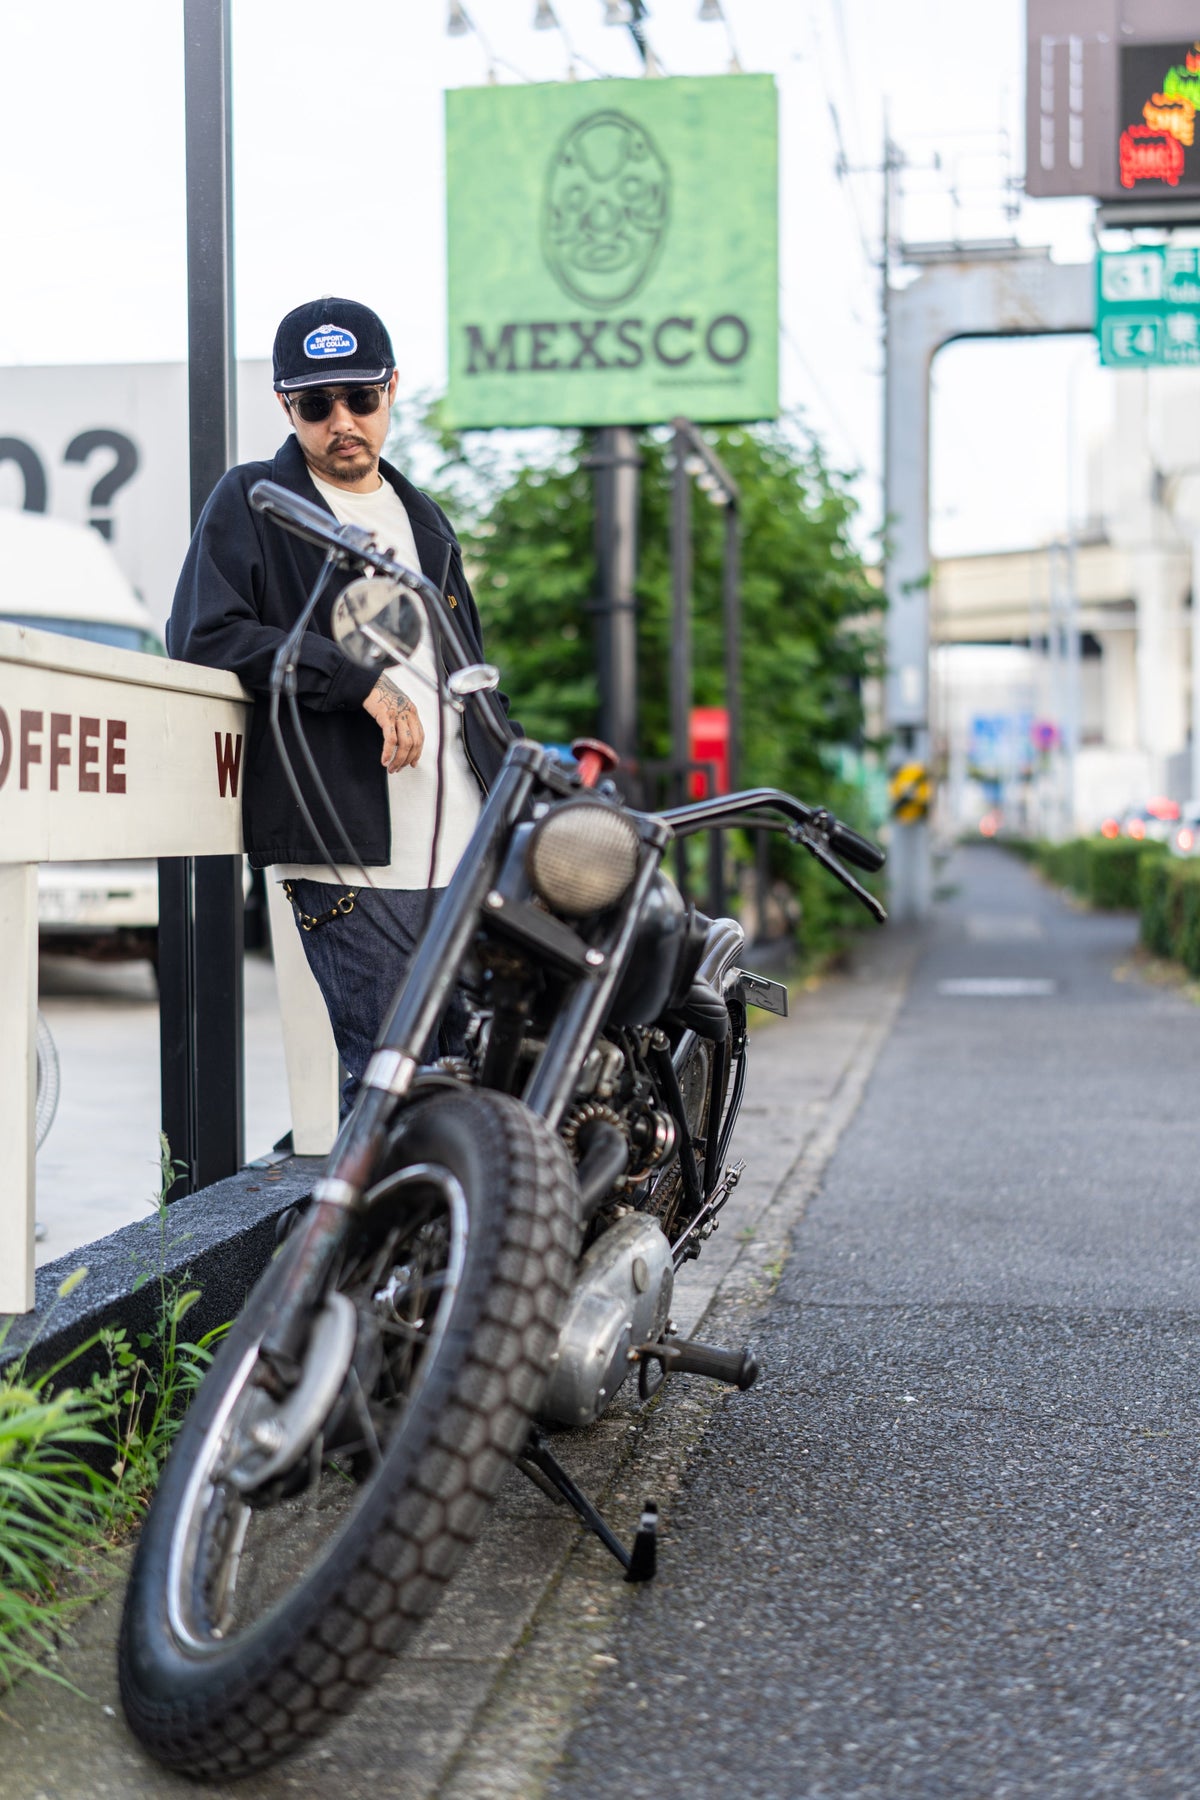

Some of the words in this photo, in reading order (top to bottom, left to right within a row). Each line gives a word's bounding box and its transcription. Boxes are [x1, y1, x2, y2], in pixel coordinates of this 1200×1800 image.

[315, 335, 343, 344] SUPPORT
[310, 342, 325, 350] BLUE
[326, 340, 350, 348] COLLAR
[463, 315, 750, 375] MEXSCO
